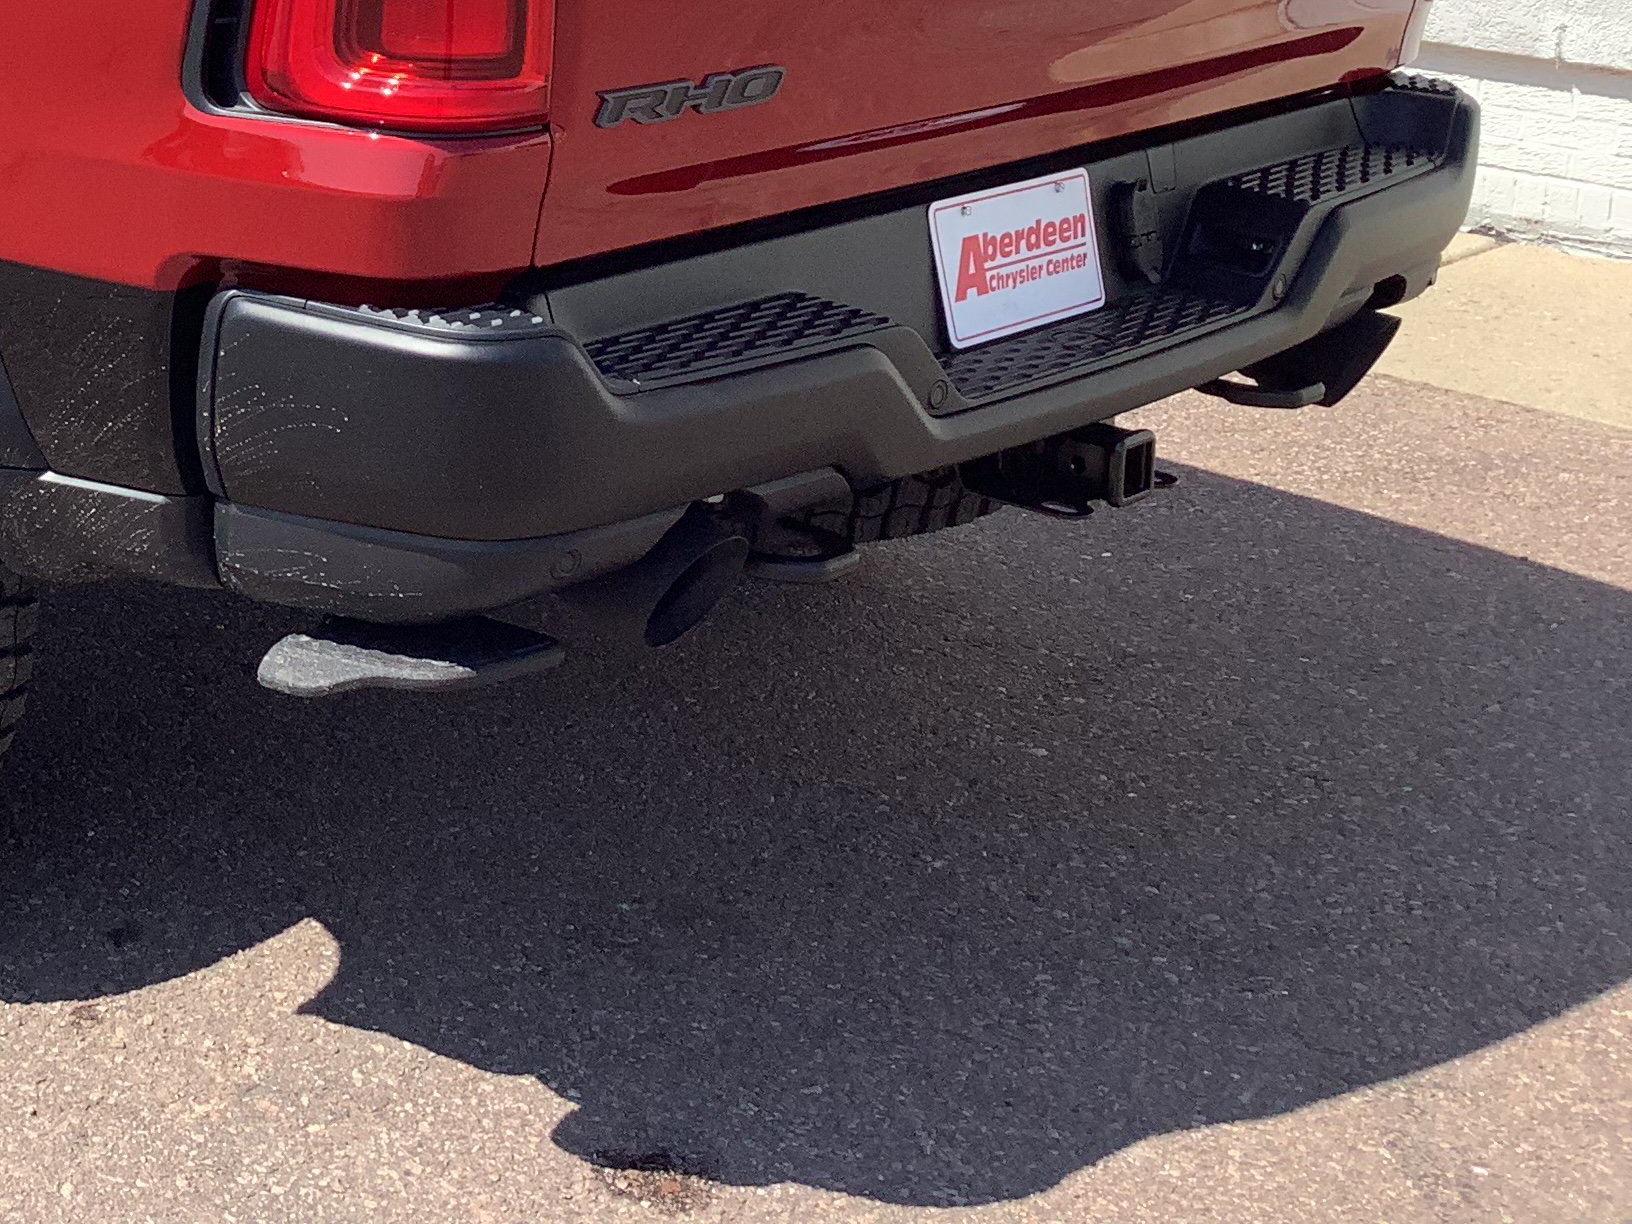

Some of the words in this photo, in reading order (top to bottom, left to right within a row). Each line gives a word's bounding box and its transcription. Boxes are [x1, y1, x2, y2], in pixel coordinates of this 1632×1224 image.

[594, 63, 786, 129] RHO
[955, 212, 1086, 303] Aberdeen
[988, 263, 1044, 292] Chrysler
[1046, 252, 1087, 277] Center
